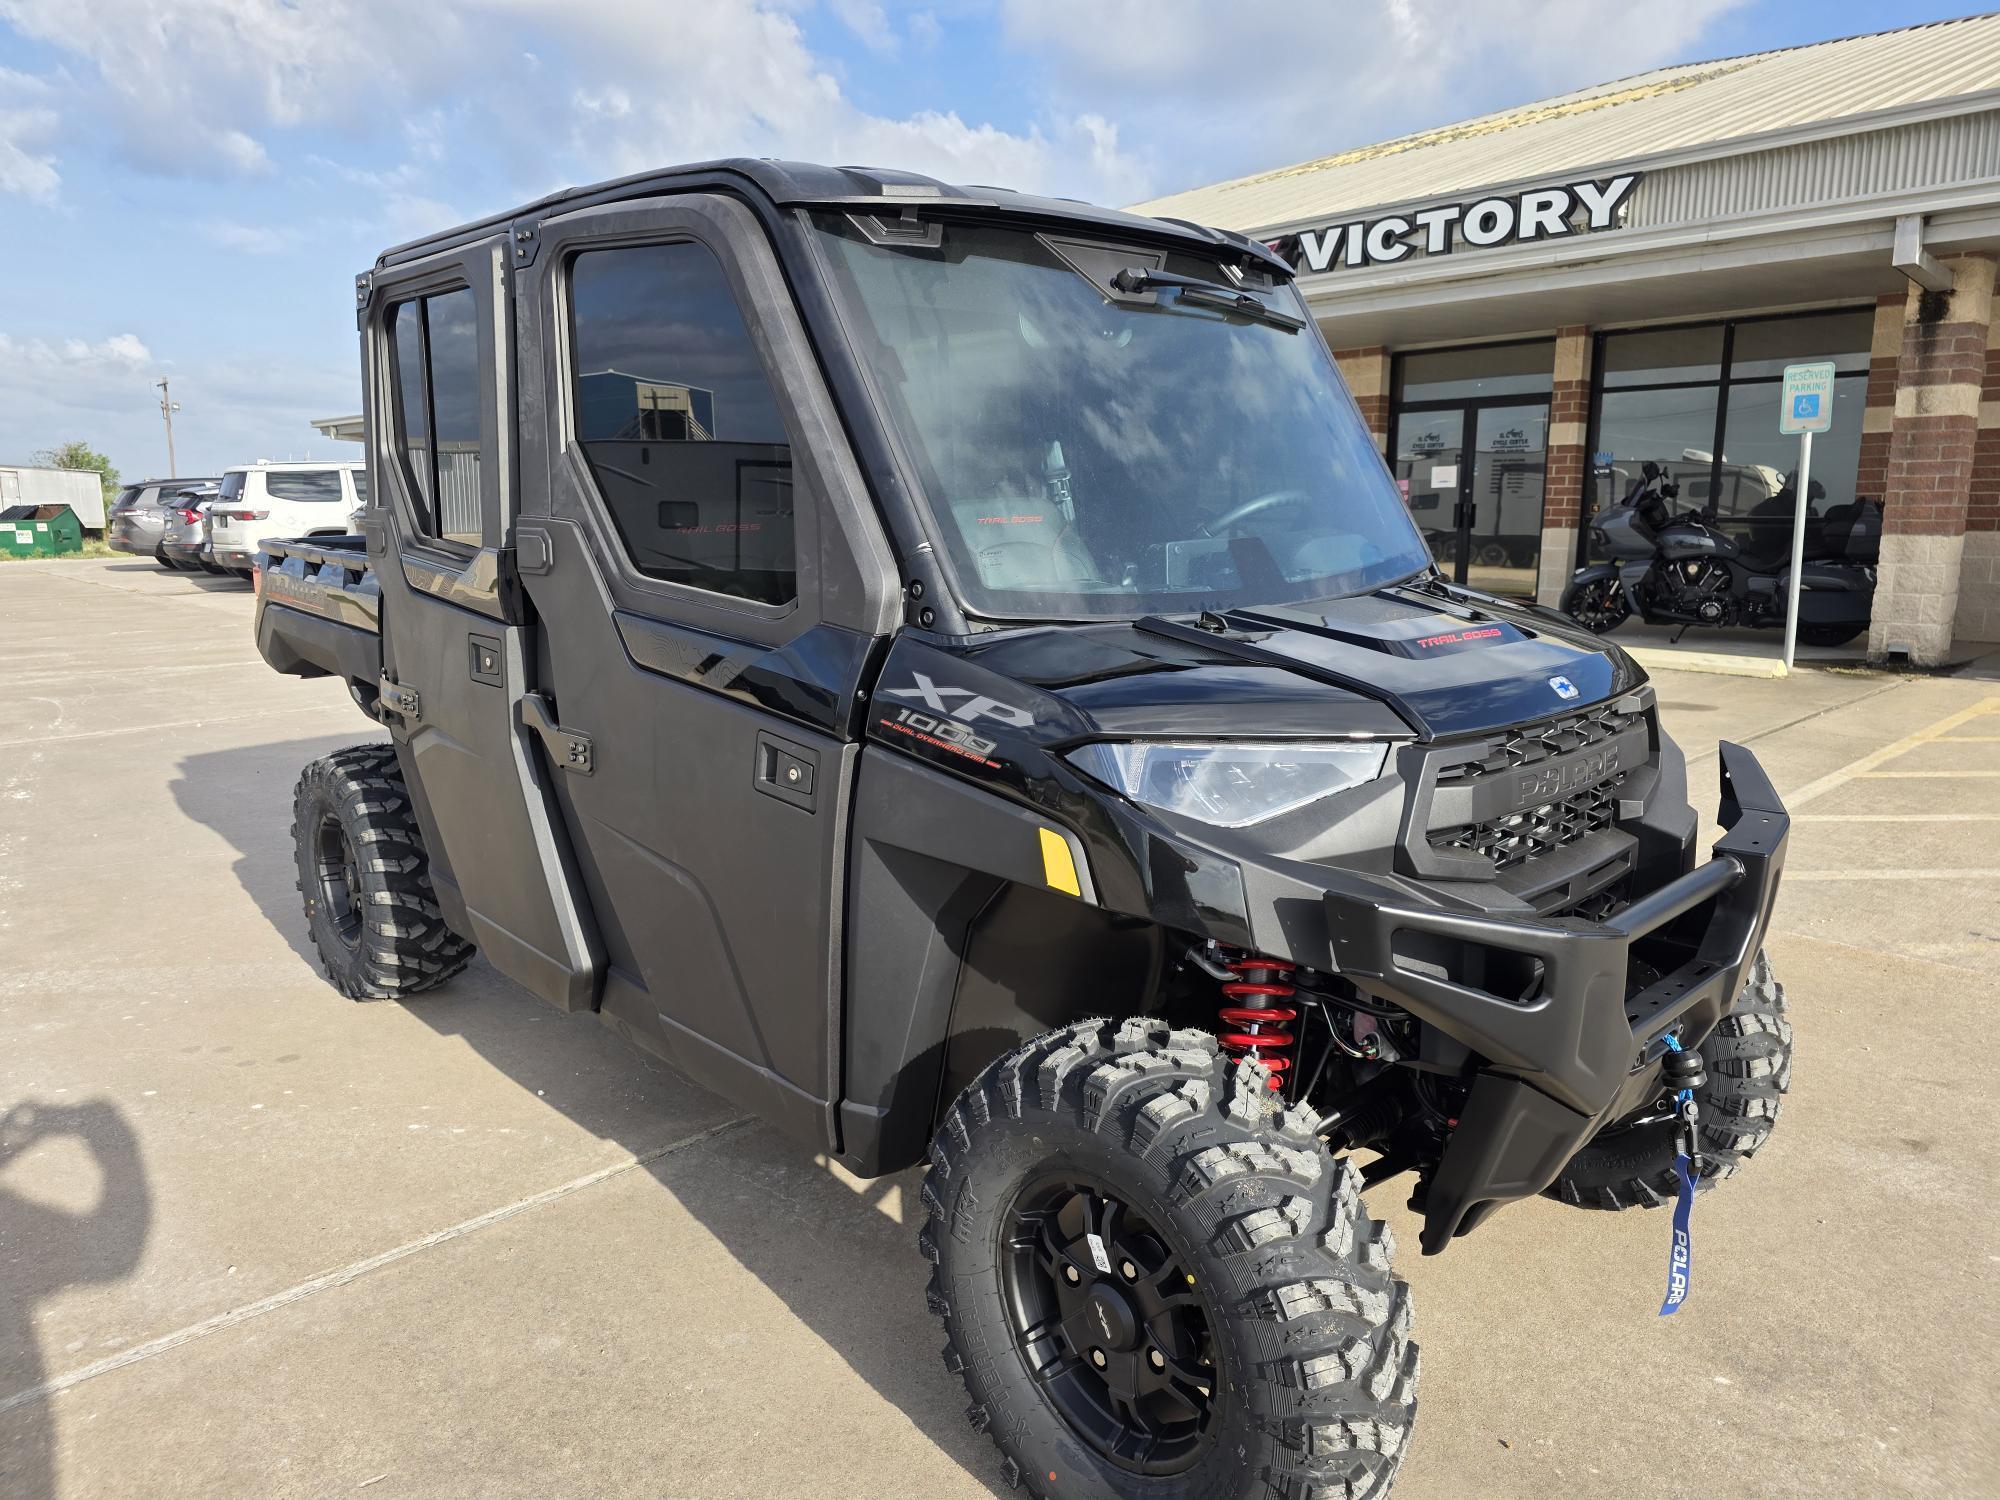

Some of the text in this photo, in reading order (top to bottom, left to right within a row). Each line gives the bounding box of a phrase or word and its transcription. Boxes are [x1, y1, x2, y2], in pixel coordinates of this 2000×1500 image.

[1299, 173, 1641, 272] VICTORY
[1786, 369, 1831, 381] RESERVED
[1789, 382, 1827, 392] PARKING
[715, 522, 762, 534] BOSS
[976, 514, 1044, 525] TRAIL BOSS
[1416, 628, 1502, 649] TRAIL BOSS
[885, 671, 1035, 727] XP
[893, 723, 916, 738] DUAL
[964, 751, 987, 763] CAM
[896, 709, 998, 756] 1000
[1517, 745, 1620, 805] POLARIS
